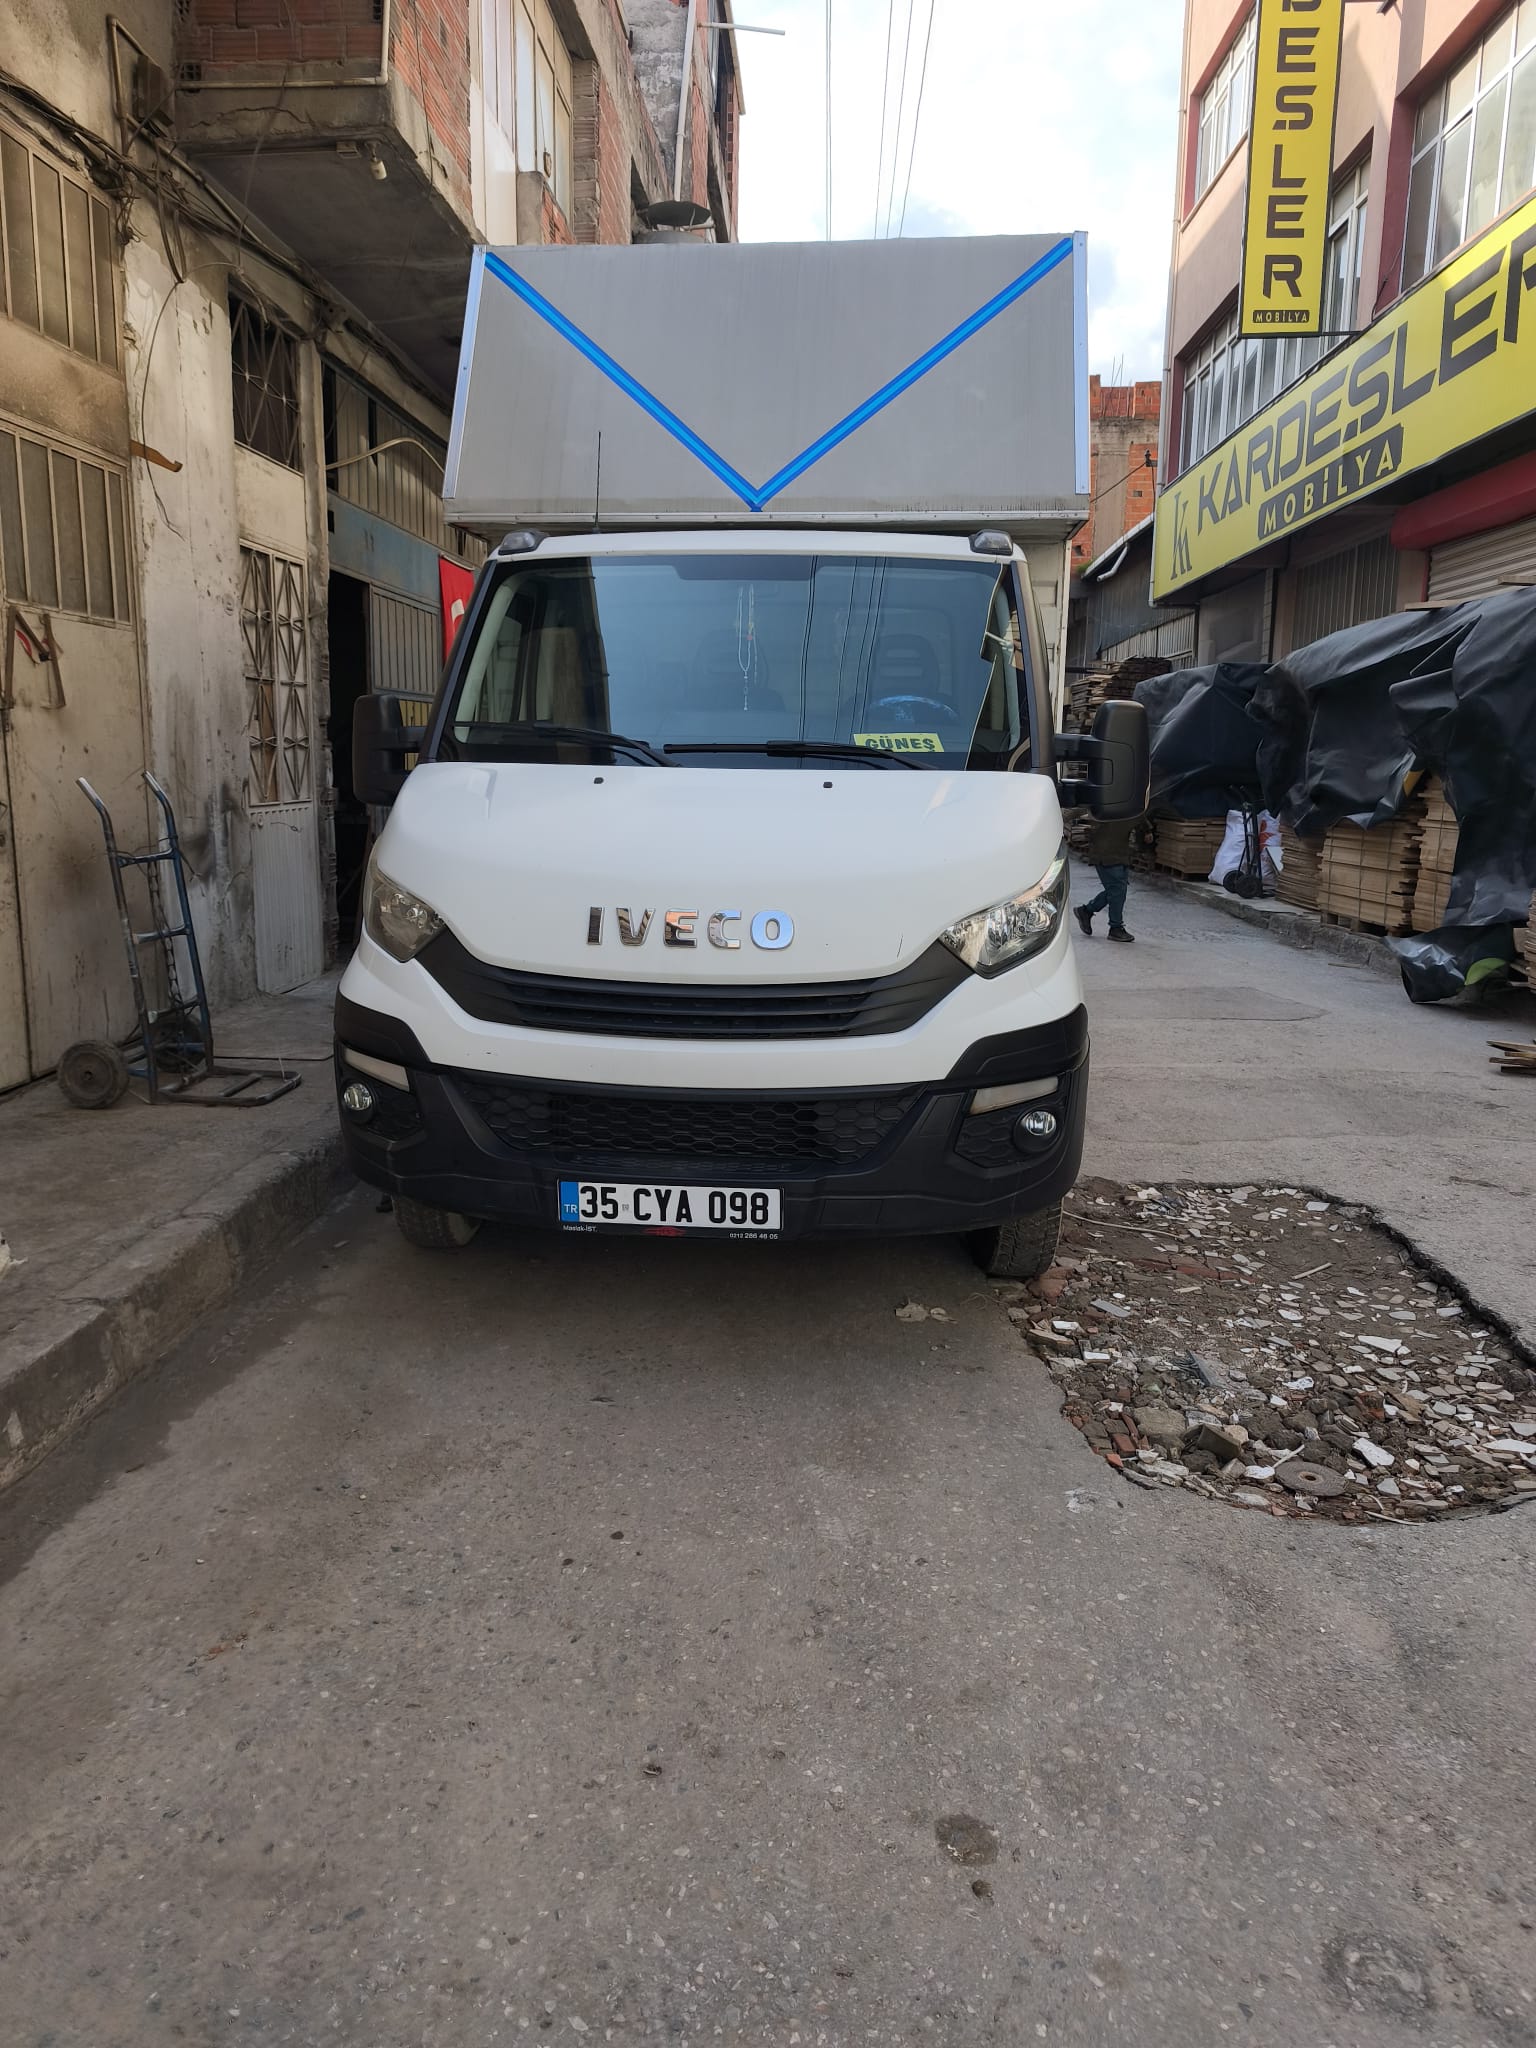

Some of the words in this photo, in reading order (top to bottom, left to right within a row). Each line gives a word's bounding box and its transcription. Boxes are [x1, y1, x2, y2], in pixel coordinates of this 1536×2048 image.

[1262, 0, 1321, 299] ESLER
[586, 906, 796, 950] IVECO
[564, 1203, 578, 1214] TR
[580, 1185, 619, 1220] 35
[633, 1188, 693, 1223] CYA
[708, 1190, 769, 1225] 098
